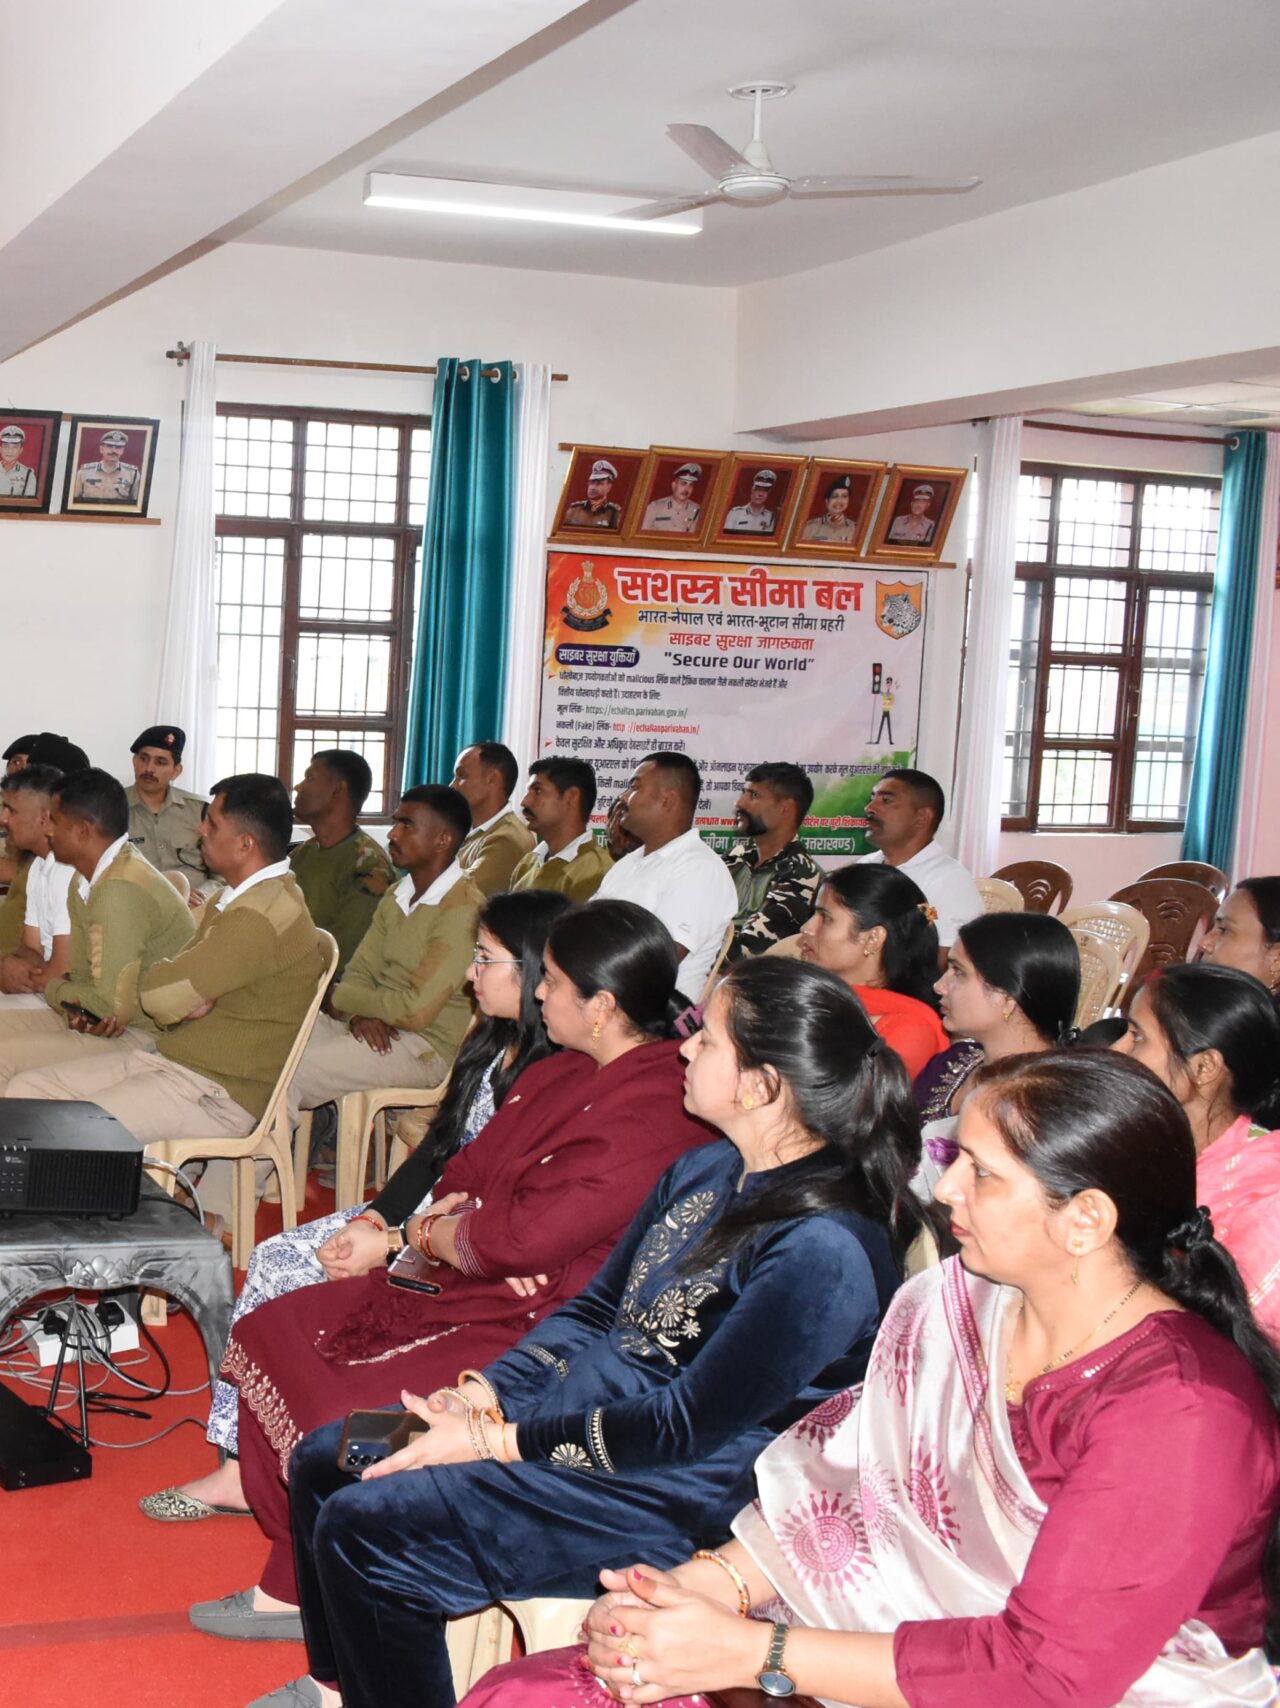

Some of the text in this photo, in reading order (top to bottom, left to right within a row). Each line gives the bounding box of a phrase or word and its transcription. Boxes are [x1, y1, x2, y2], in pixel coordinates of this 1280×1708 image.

[617, 568, 864, 611] सशस्त्र सीमा बल
[638, 608, 845, 632] भारत-नेपाल एवं भारत-भूटान सीमा प्रहरी
[669, 633, 711, 647] साइबर
[716, 635, 752, 651] सुरक्षा
[558, 649, 585, 662] साइबर
[586, 650, 608, 665] सुरक्षा
[733, 656, 760, 669] Our
[626, 674, 654, 684] malicious
[655, 674, 669, 684] लिंक
[557, 704, 568, 716] मूल
[556, 719, 574, 730] नकली
[575, 720, 595, 732] (Fake)
[555, 736, 571, 748] केवल
[572, 736, 592, 751] सुरक्षित
[594, 737, 606, 748] और
[650, 738, 657, 751] ही
[621, 757, 630, 769] को
[698, 760, 737, 773] और ऑनलाइन
[597, 776, 613, 788] किसी
[713, 781, 731, 792] आपका
[821, 817, 830, 827] पर
[831, 815, 842, 830] पूरी
[702, 833, 729, 849] सीमा
